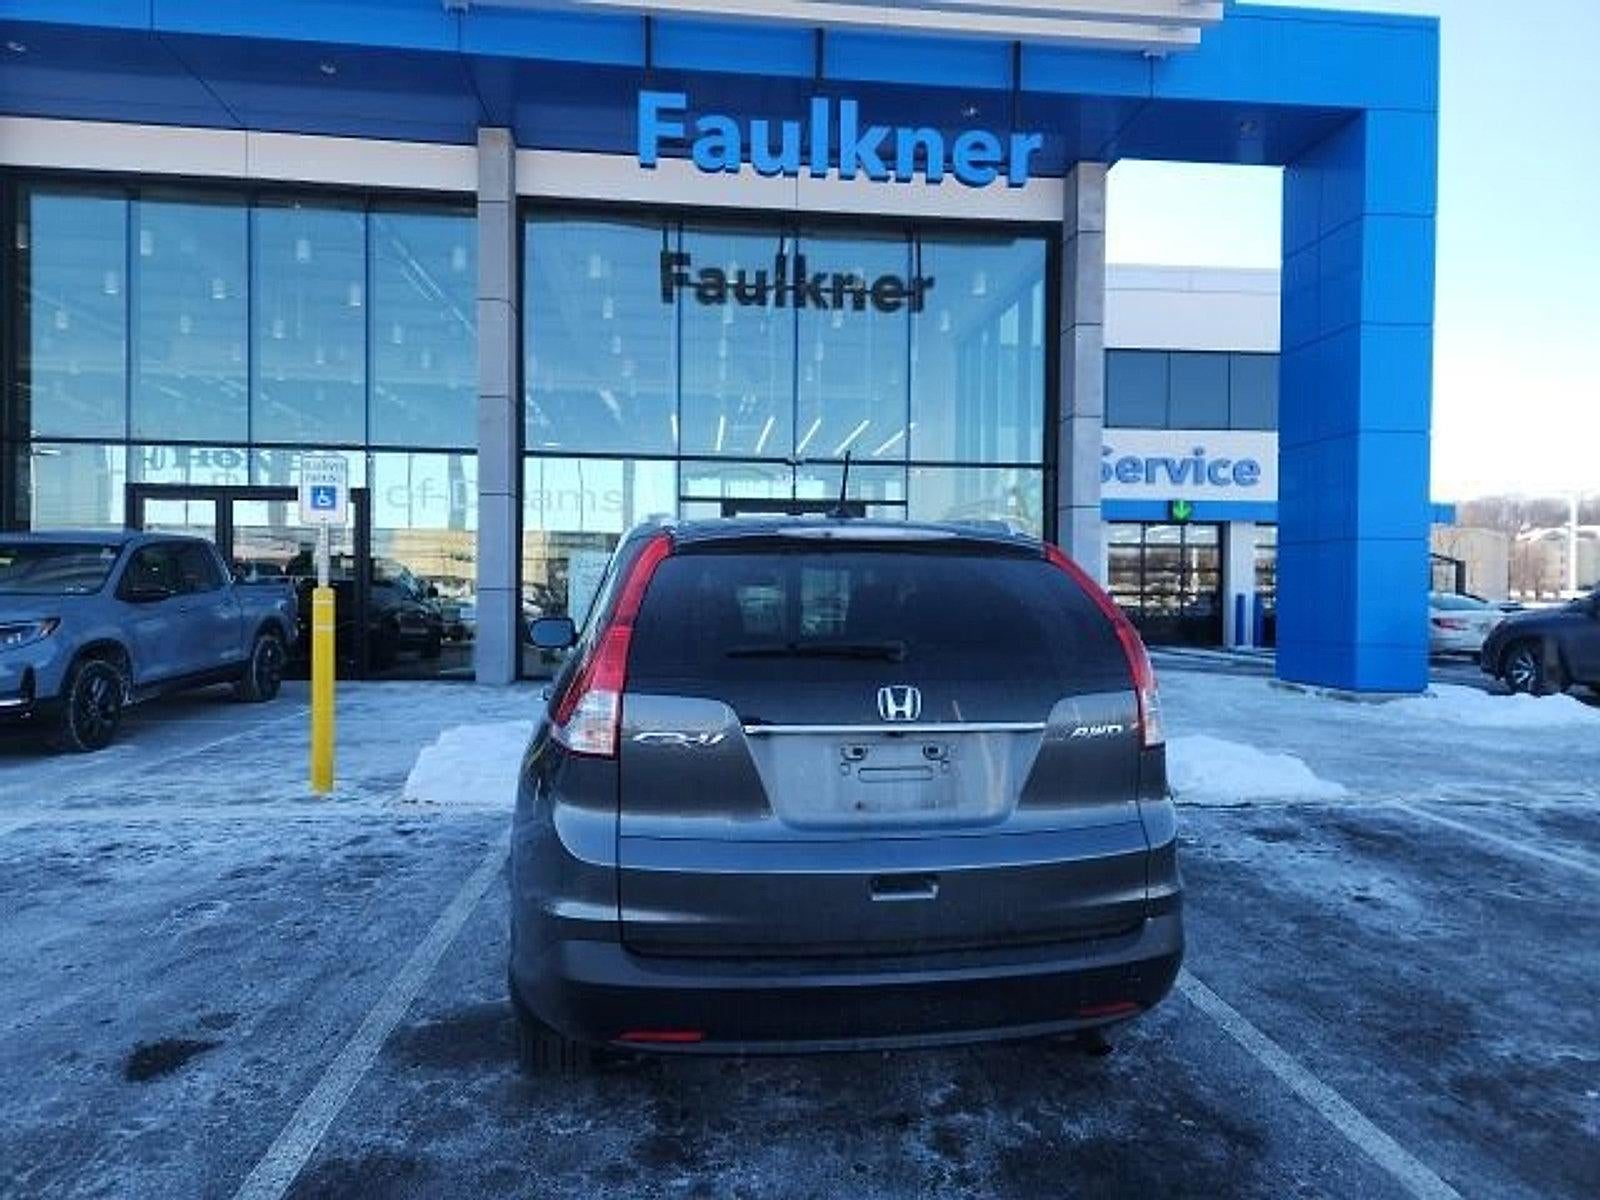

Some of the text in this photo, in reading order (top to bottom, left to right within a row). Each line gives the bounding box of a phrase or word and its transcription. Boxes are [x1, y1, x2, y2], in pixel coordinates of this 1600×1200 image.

[637, 91, 1042, 188] Faulkner
[660, 250, 934, 313] Faulkner
[1071, 725, 1122, 738] AWD
